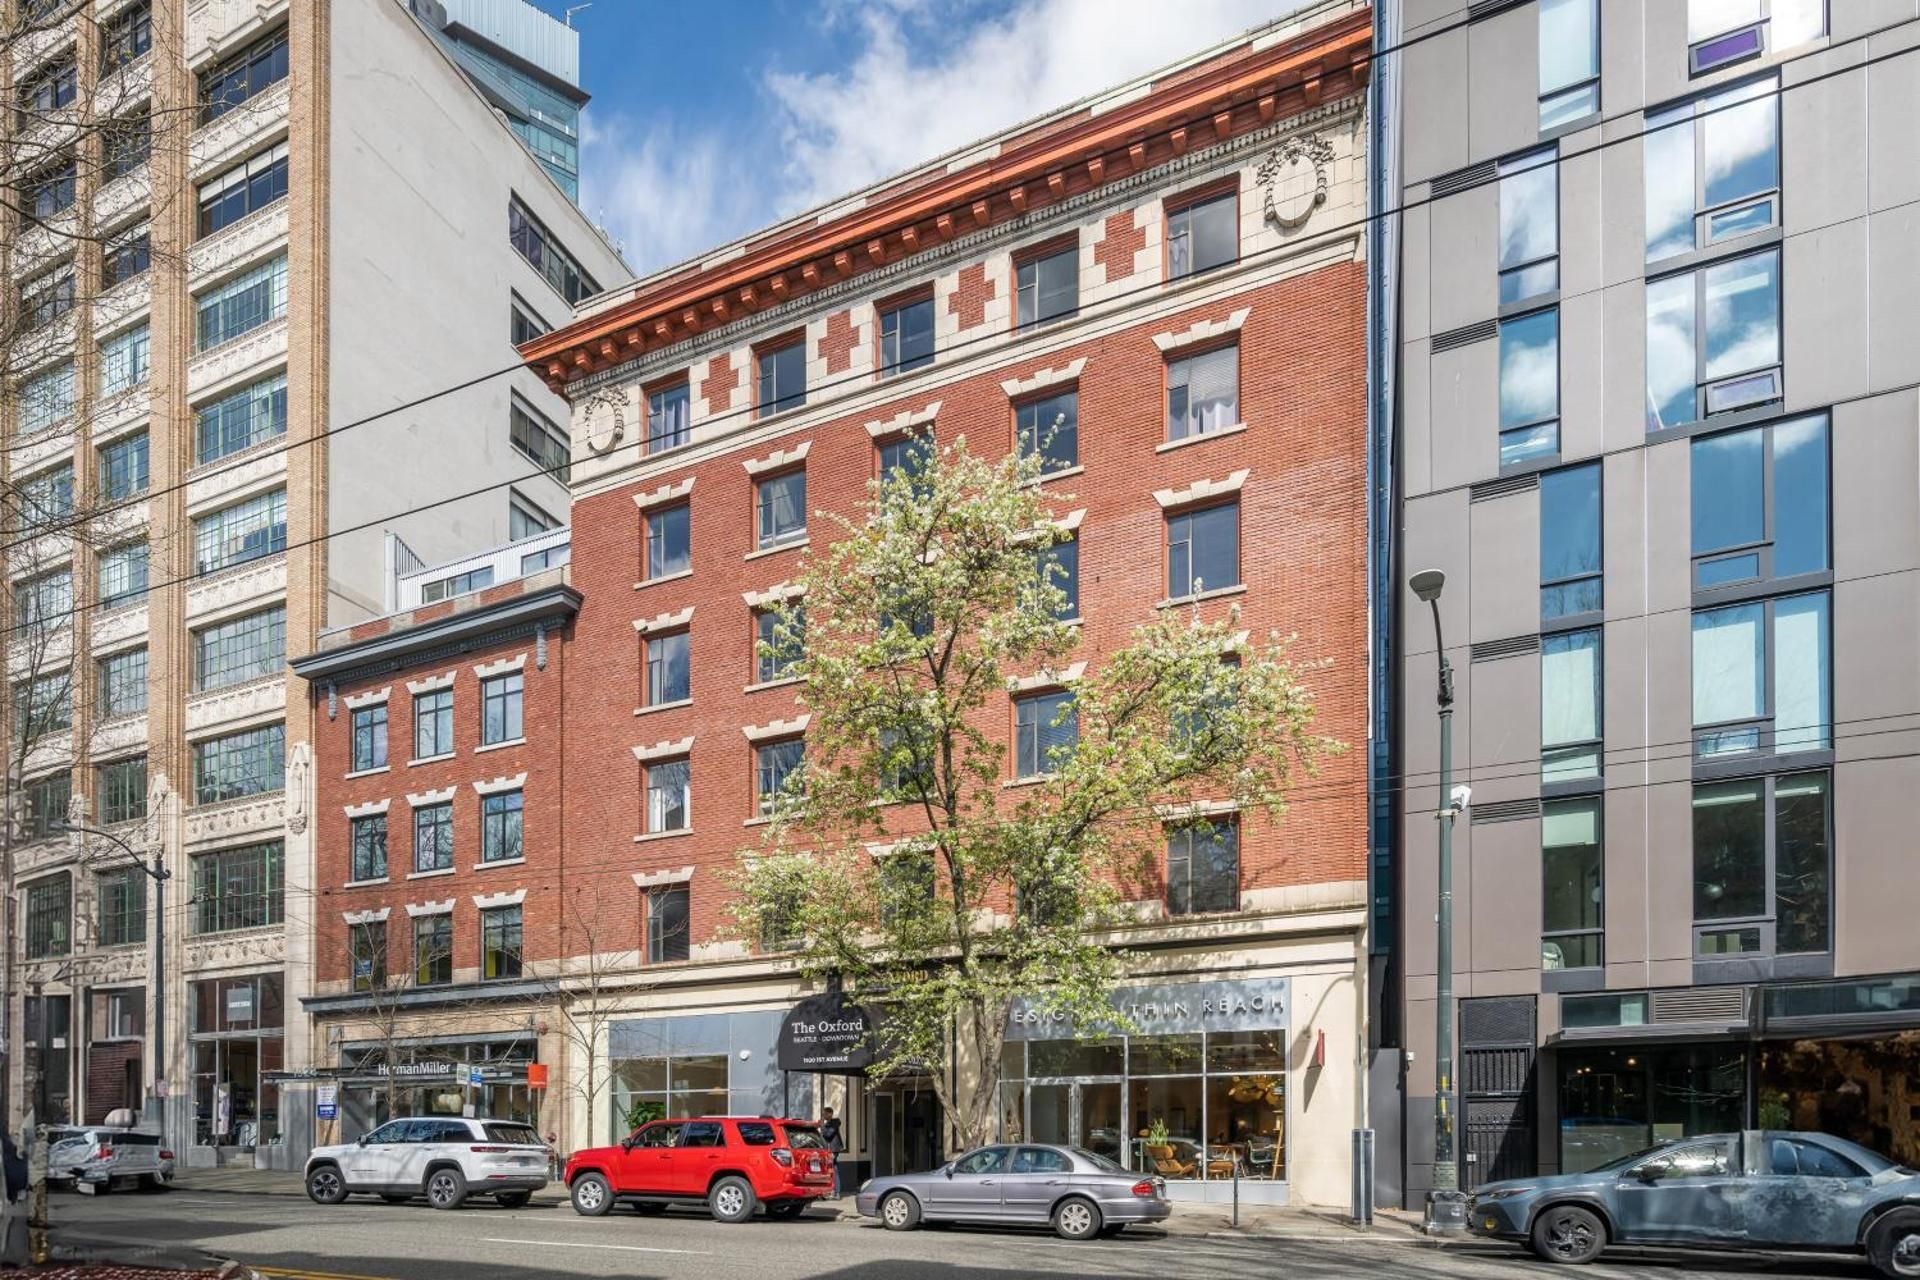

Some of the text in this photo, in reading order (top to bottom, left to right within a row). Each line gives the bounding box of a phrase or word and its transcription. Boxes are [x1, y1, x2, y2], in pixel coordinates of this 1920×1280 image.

[1014, 995, 1284, 1023] ESIG THIN REACH
[791, 1018, 863, 1034] The Oxford
